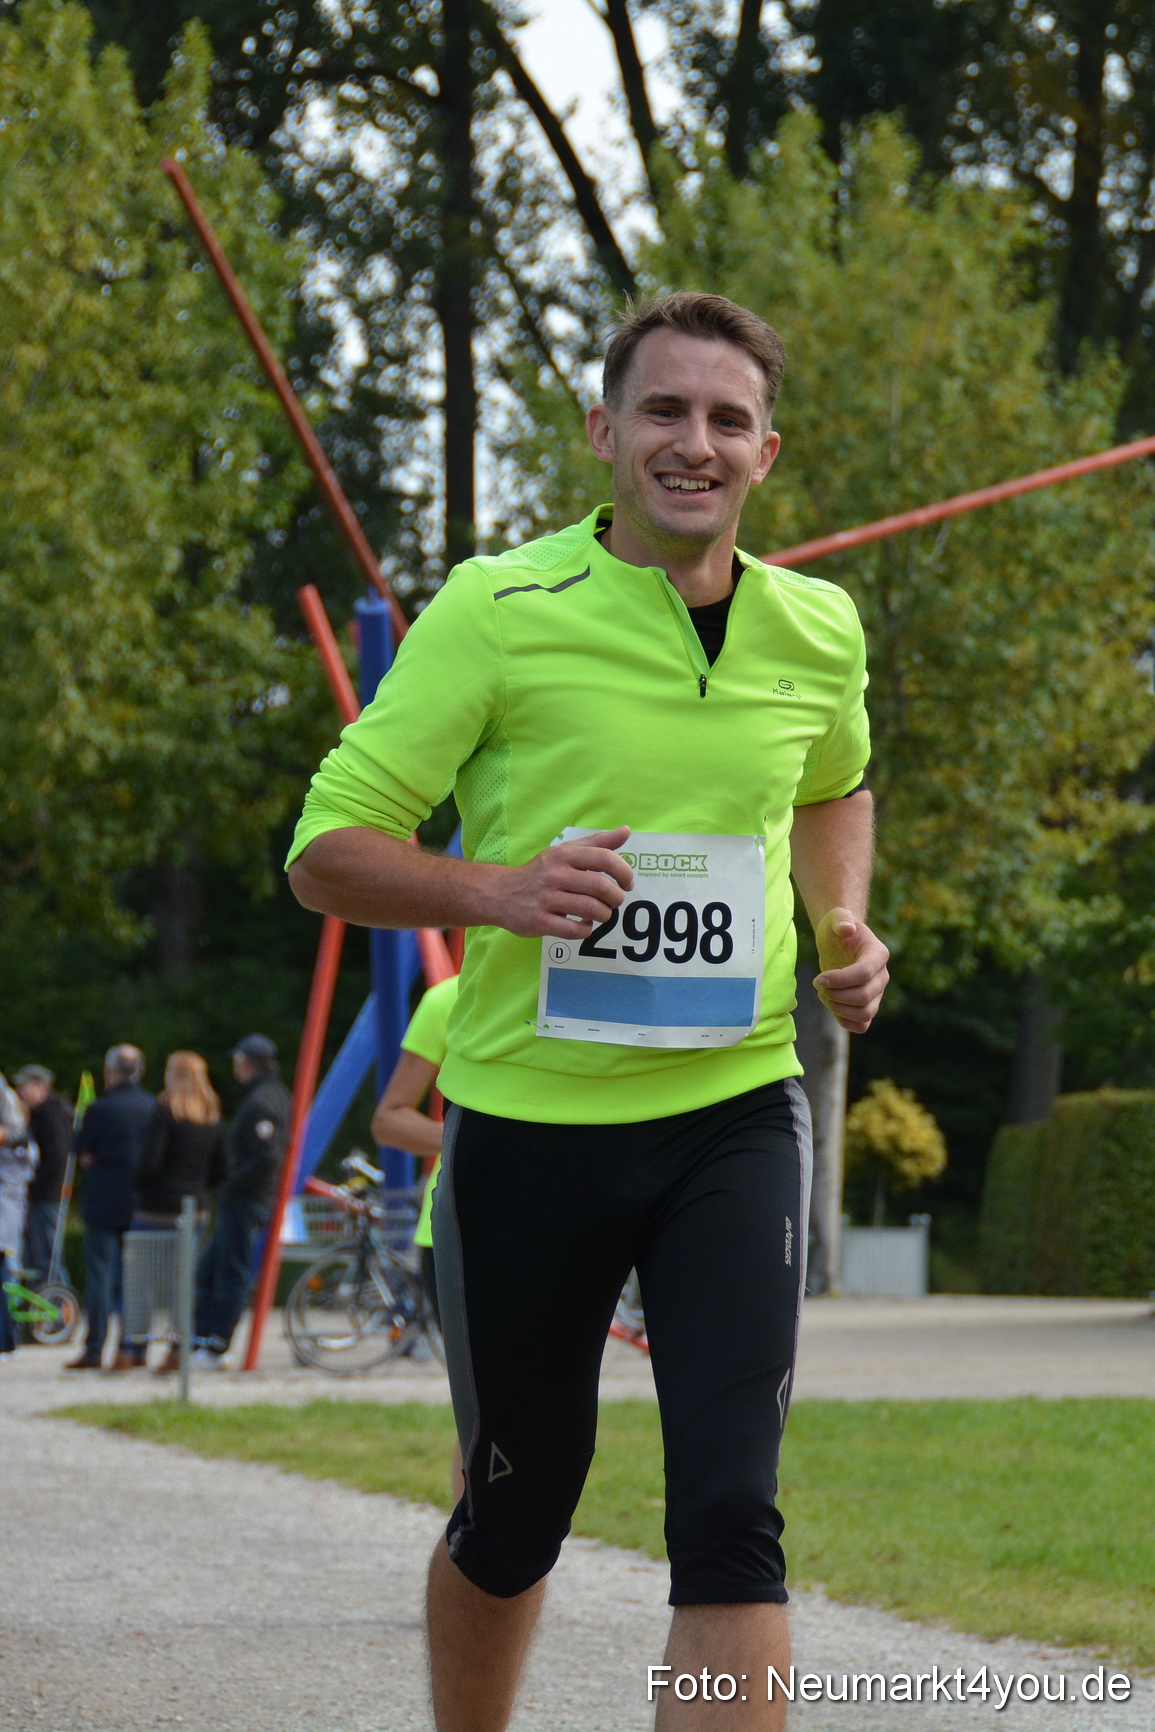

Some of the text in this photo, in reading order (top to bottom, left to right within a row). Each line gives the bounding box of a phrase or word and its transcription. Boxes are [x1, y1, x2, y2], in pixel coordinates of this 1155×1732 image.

[638, 853, 709, 872] BOCK
[579, 899, 734, 965] 2998
[555, 947, 564, 959] D
